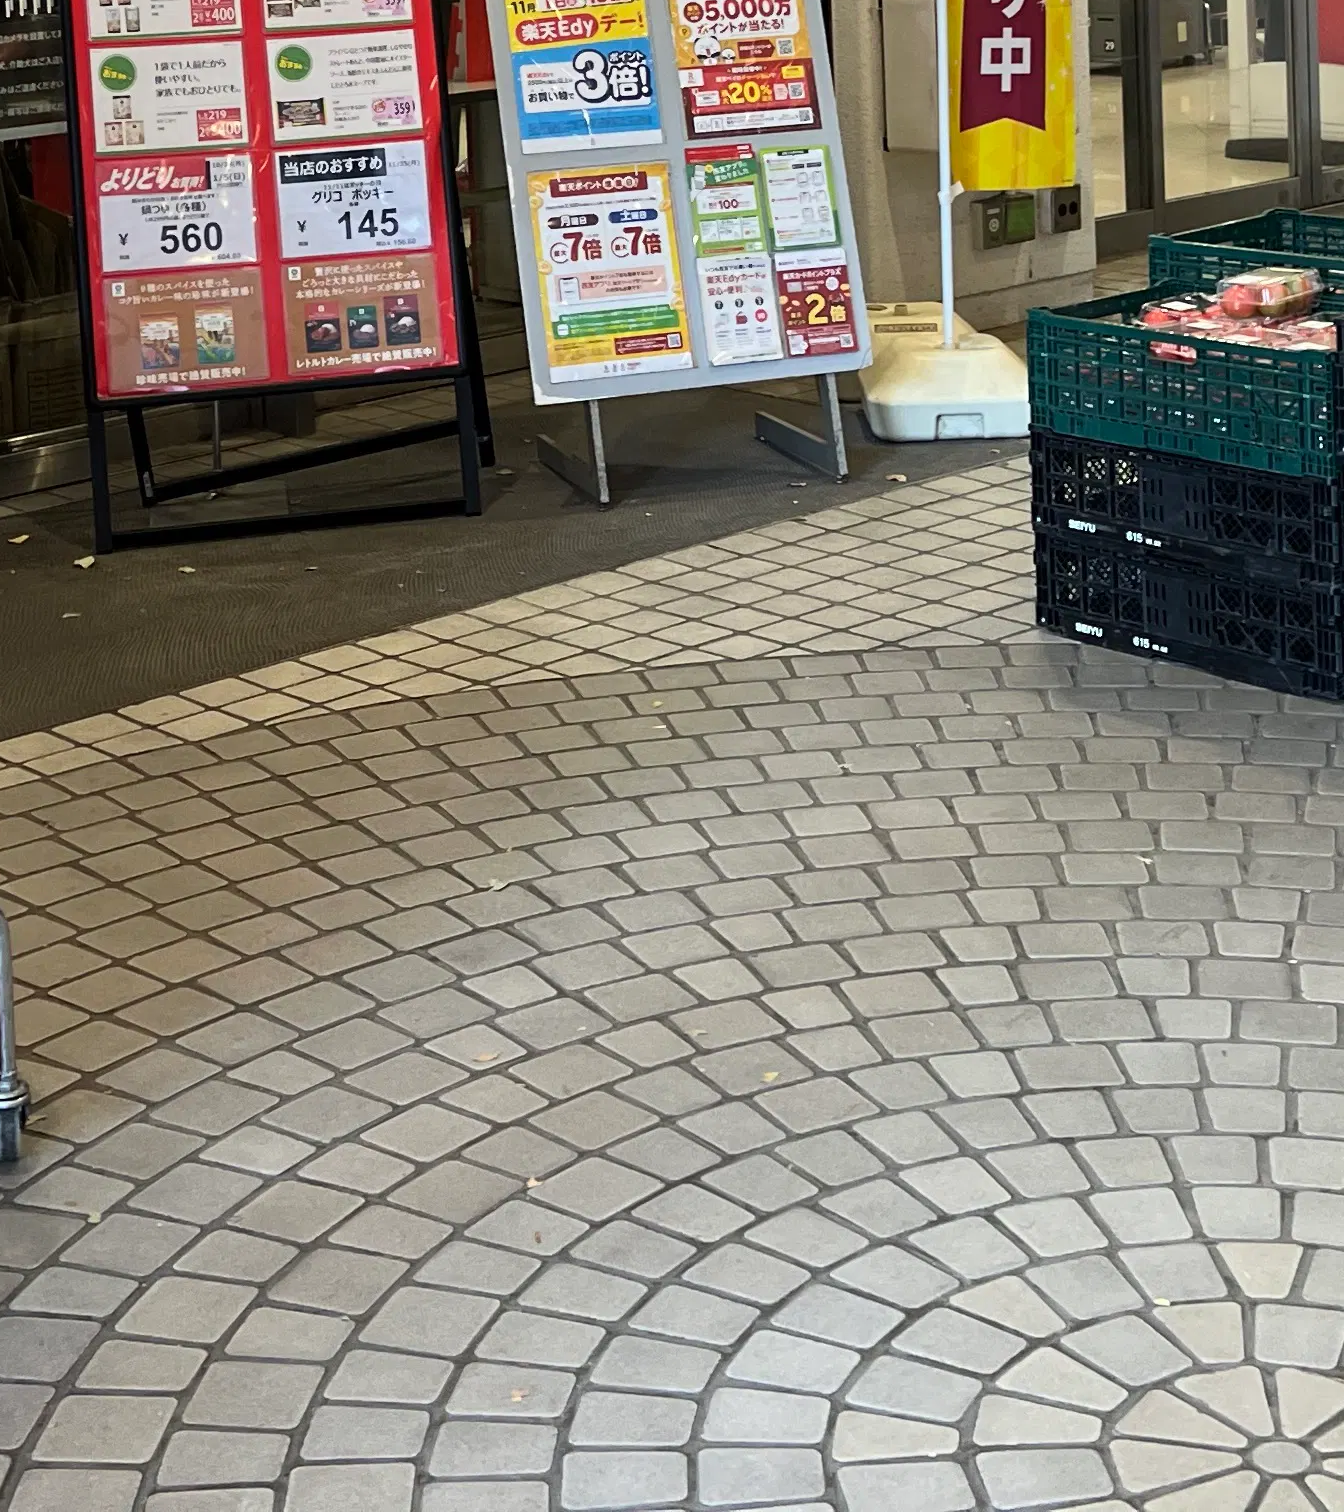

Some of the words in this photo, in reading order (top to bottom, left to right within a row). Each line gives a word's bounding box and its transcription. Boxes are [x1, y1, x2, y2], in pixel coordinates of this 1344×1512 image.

[608, 50, 645, 63] ポイント
[284, 155, 383, 177] 当店のおすすめ
[311, 190, 343, 204] グリコ
[351, 187, 394, 201] ポッキー
[337, 207, 399, 240] 145
[160, 221, 223, 254] 560
[1068, 518, 1096, 534] SEIYU
[1125, 530, 1144, 544] 615
[1075, 621, 1104, 638] SEIYU
[1132, 635, 1151, 649] 615
